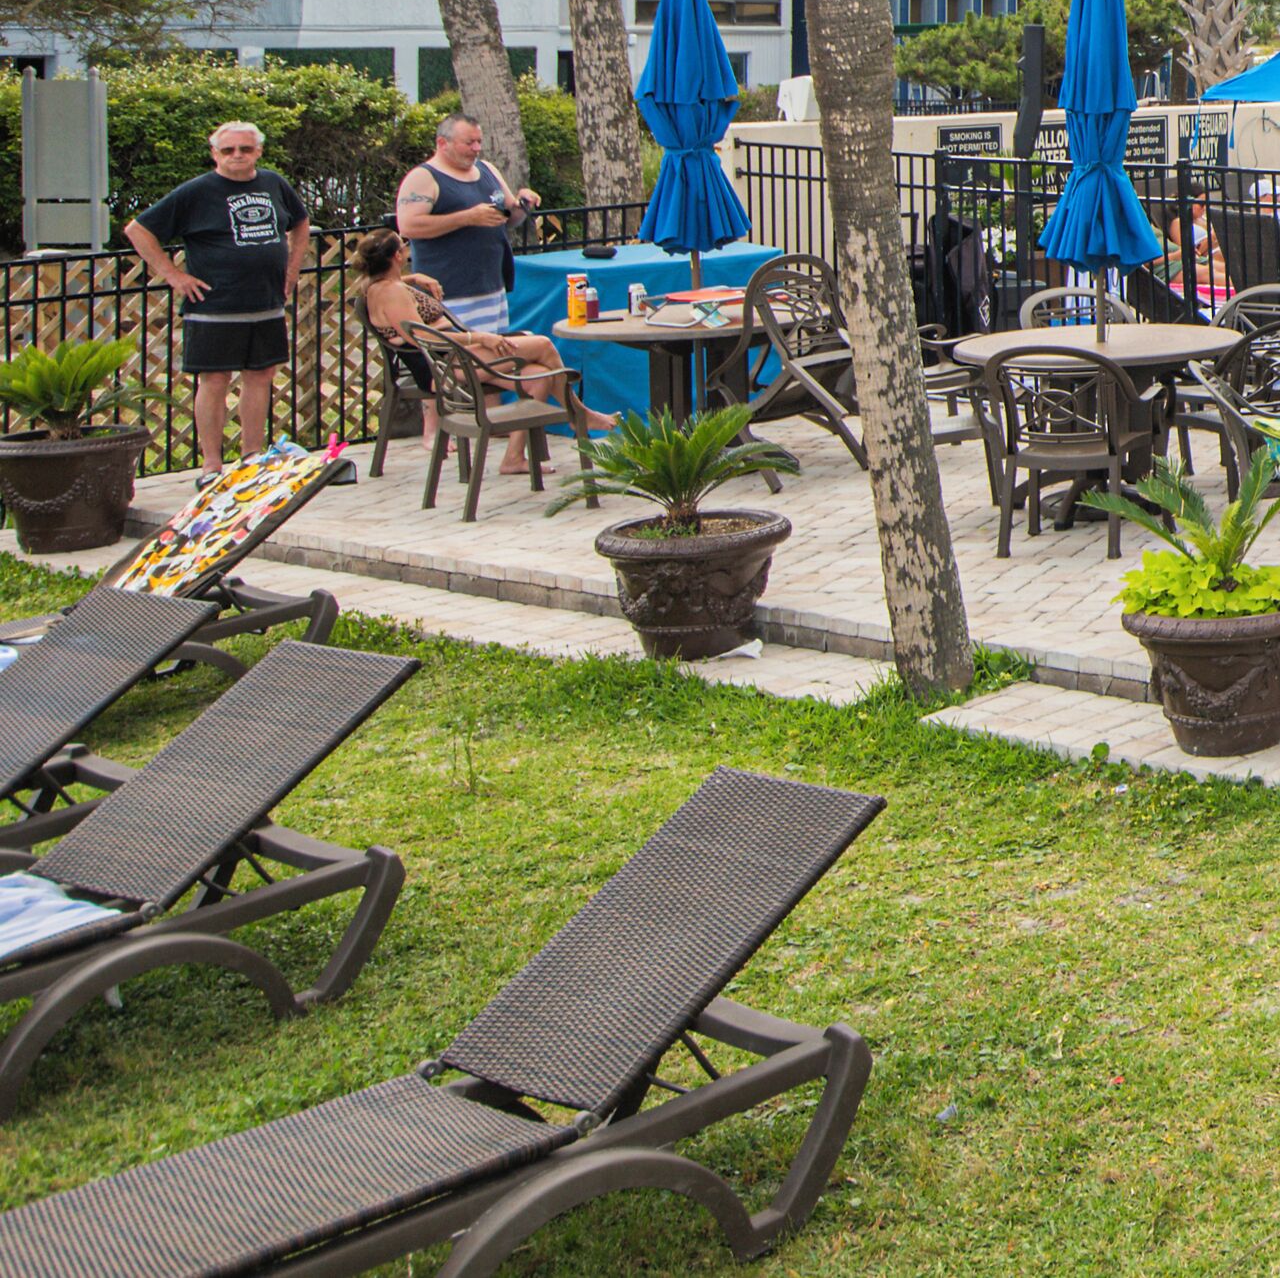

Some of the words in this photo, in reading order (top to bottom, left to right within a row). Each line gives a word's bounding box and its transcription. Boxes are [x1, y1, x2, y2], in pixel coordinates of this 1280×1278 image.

[1179, 115, 1190, 137] NO
[949, 132, 982, 141] SMOKING
[984, 131, 991, 140] IS
[1139, 135, 1159, 145] Before
[959, 142, 998, 152] PERMITTED
[1133, 147, 1141, 156] 30
[1201, 136, 1219, 159] DUTY
[1036, 149, 1067, 161] ATER
